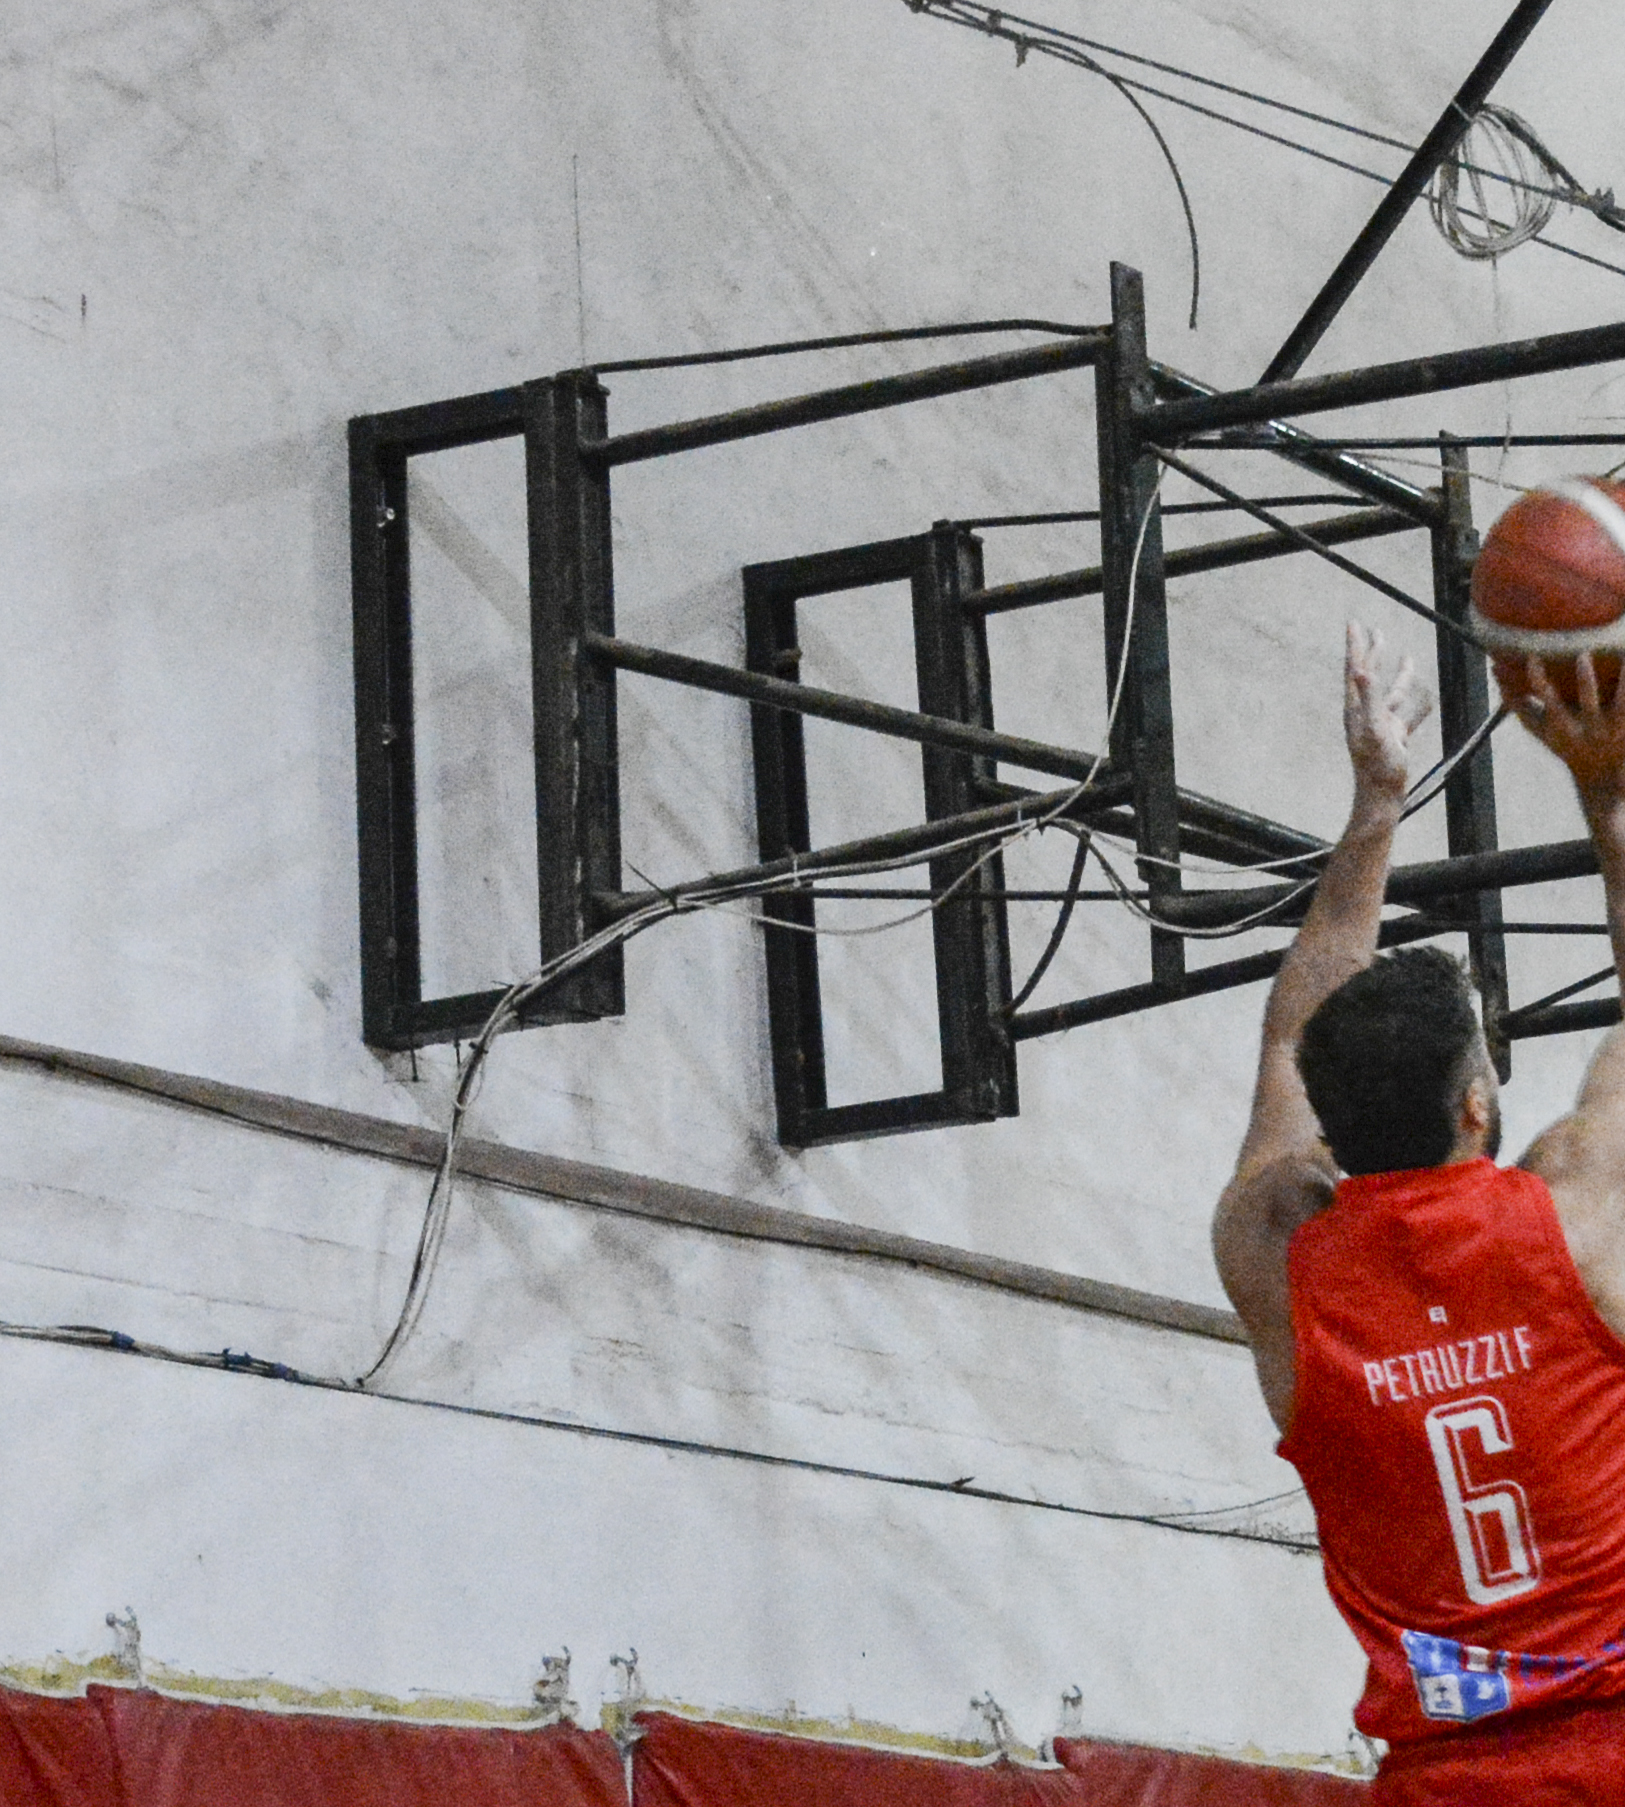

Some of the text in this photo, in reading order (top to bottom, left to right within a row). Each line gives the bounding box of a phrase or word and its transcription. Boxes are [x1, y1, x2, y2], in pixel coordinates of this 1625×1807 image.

[1362, 1326, 1532, 1406] PETRUZZI F
[1425, 1395, 1543, 1606] 6
